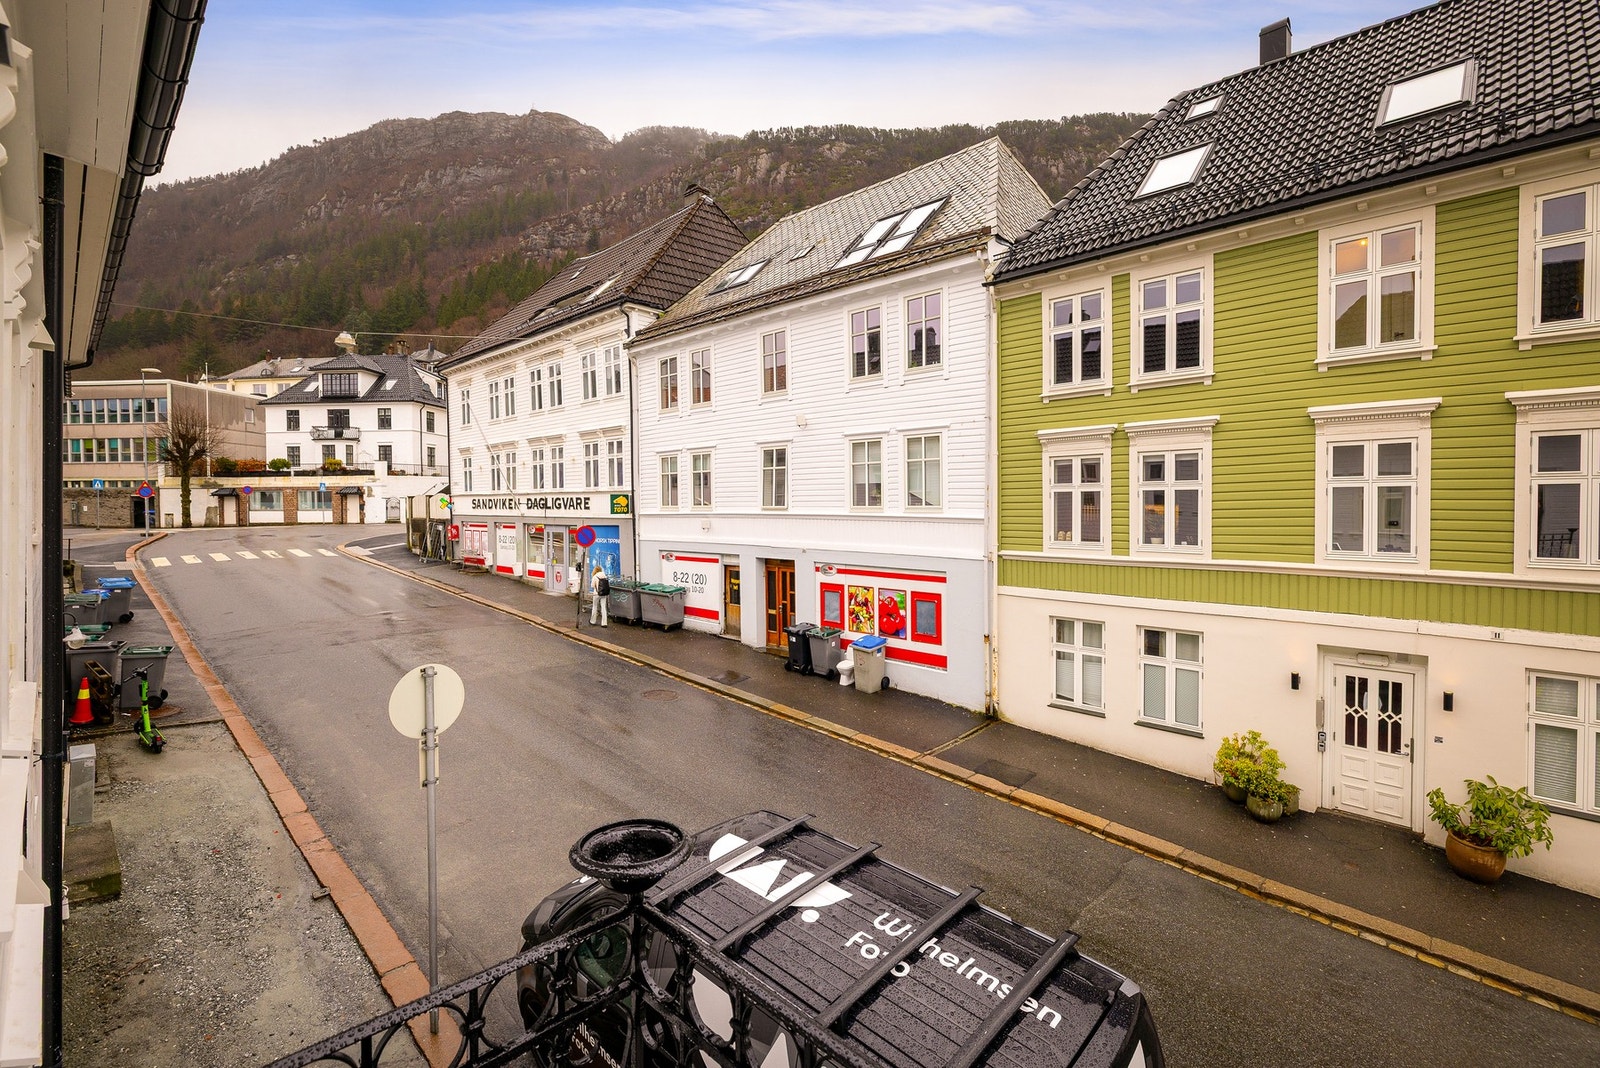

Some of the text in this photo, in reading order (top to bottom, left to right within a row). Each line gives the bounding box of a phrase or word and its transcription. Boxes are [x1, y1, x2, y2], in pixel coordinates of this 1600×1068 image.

[472, 497, 591, 511] SANDVIKEN DAGLIGVARE
[672, 571, 708, 586] 8-22 (20)
[844, 930, 911, 978] Foo
[873, 912, 1063, 1030] Wihelmsen
